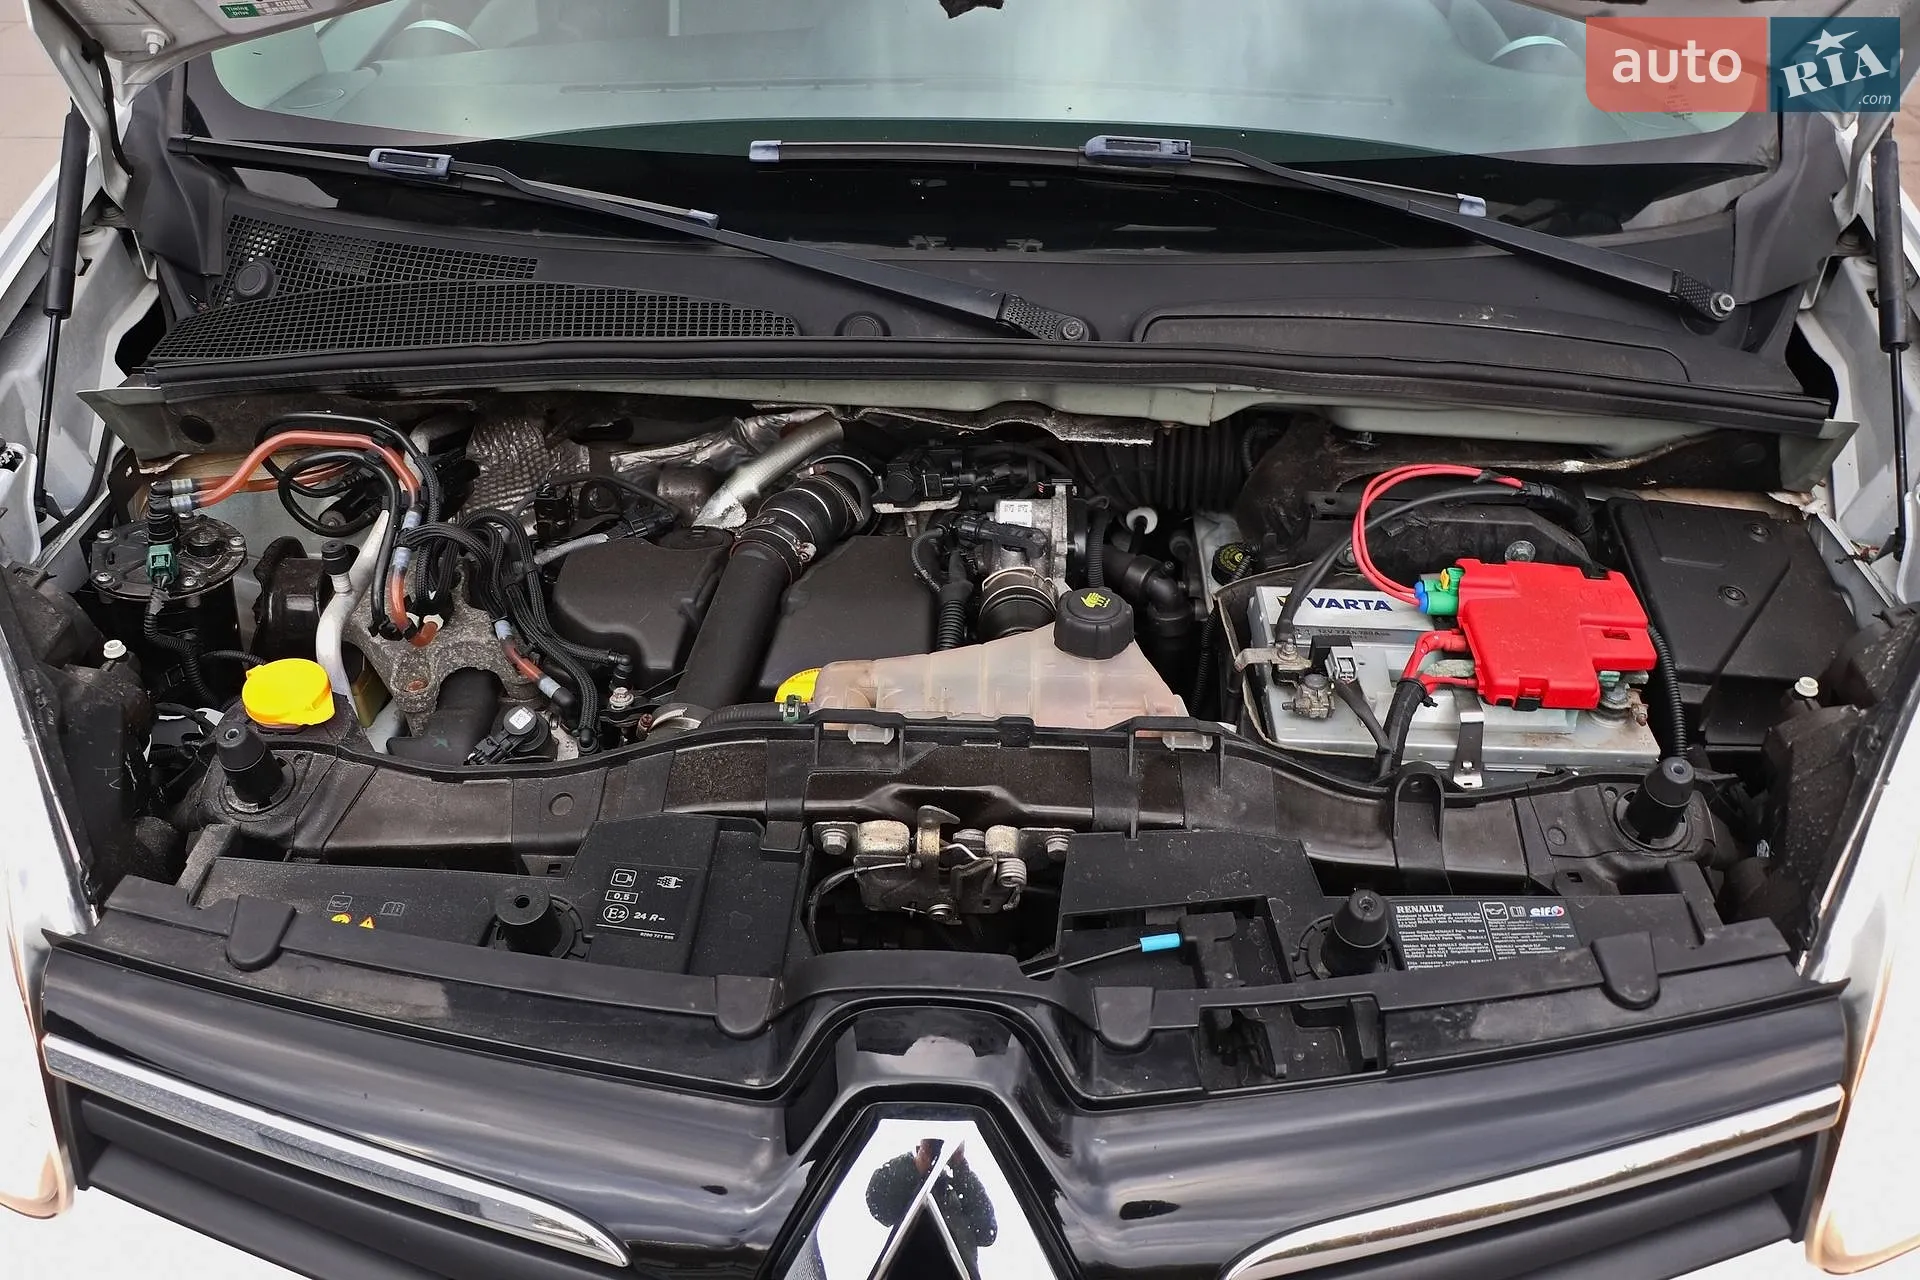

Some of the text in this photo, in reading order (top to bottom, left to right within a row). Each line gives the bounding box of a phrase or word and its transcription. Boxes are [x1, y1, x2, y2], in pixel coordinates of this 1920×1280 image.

[1306, 597, 1393, 612] VARTA
[607, 907, 626, 919] E2
[633, 912, 647, 920] 24
[1396, 904, 1445, 914] RENAULT
